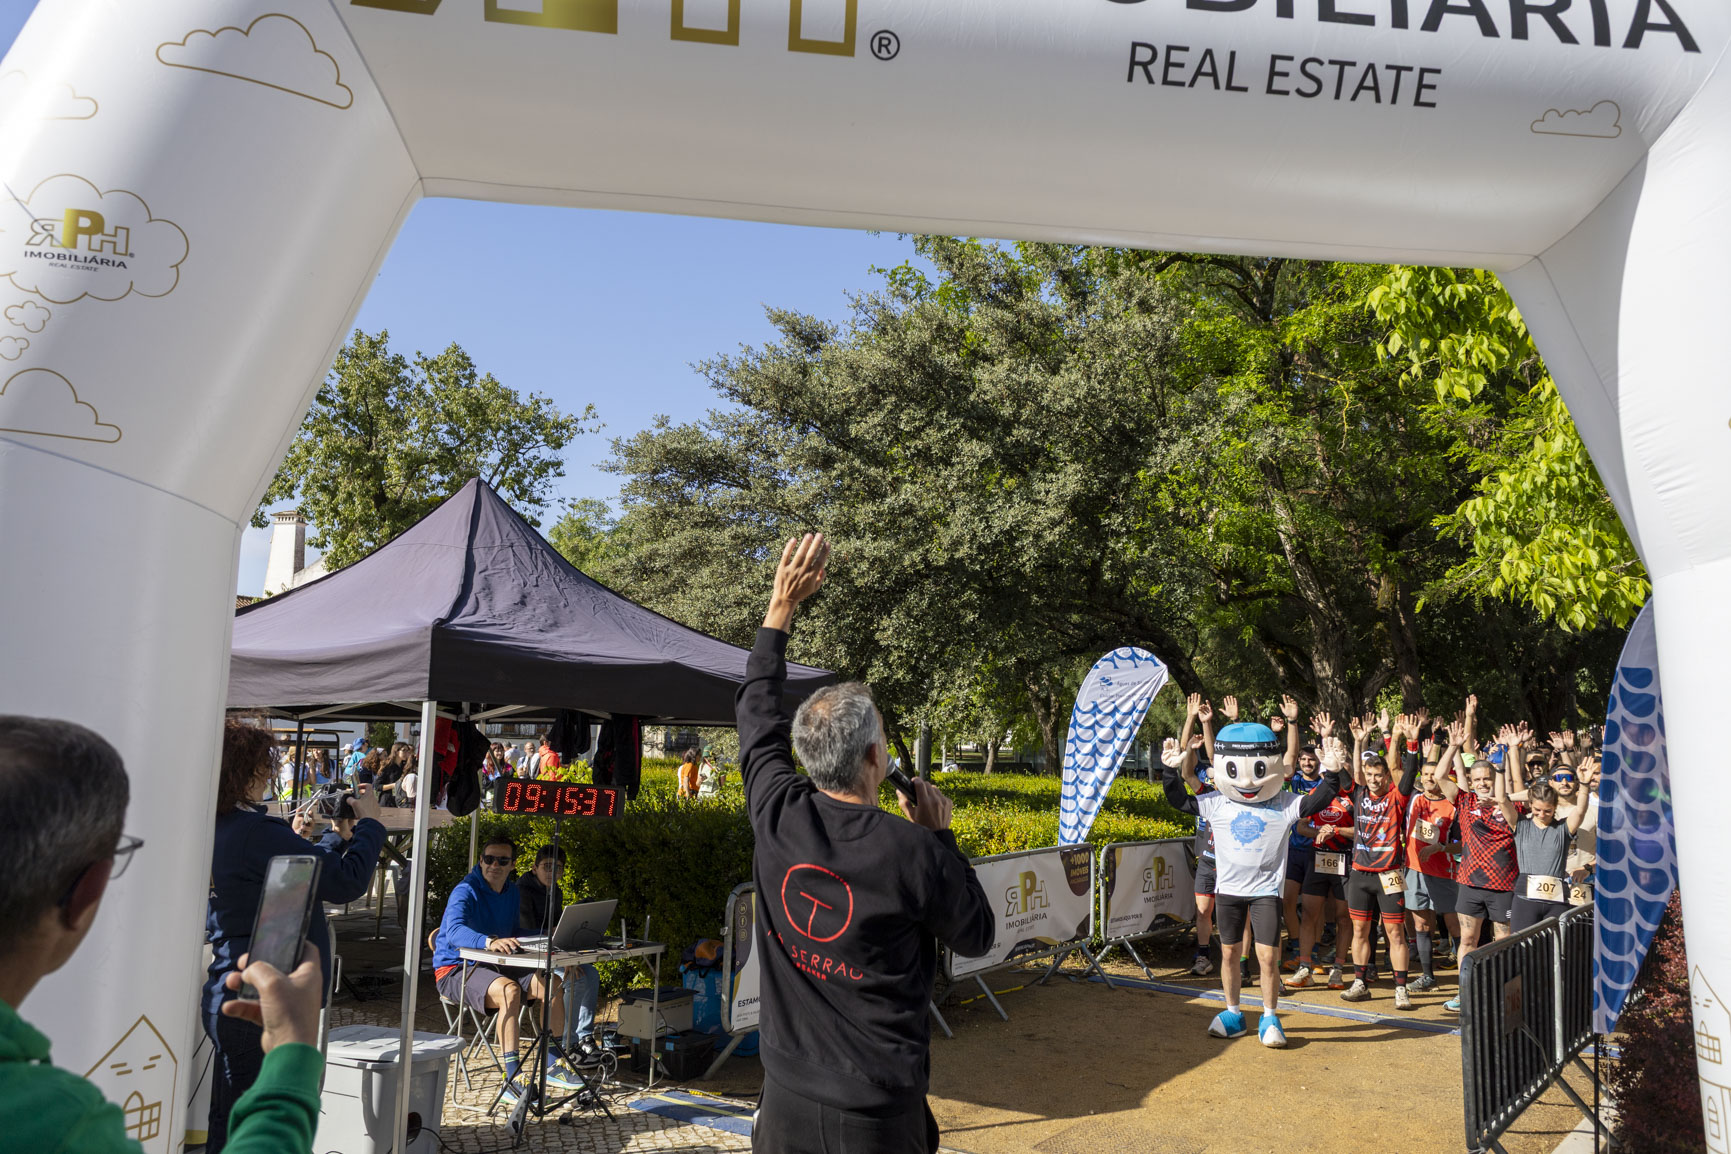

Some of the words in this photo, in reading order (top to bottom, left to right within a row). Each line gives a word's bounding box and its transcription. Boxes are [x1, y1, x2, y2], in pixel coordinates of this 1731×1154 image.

[1127, 41, 1249, 92] REAL
[1265, 54, 1442, 108] ESTATE
[24, 250, 127, 269] IMOBILIÁRIA
[503, 782, 616, 817] 09:15:37
[1419, 826, 1433, 837] 139
[1321, 858, 1338, 868] 166
[1536, 882, 1556, 893] 207
[1573, 889, 1587, 899] 24
[1005, 912, 1048, 930] IMOBILIÁRIA
